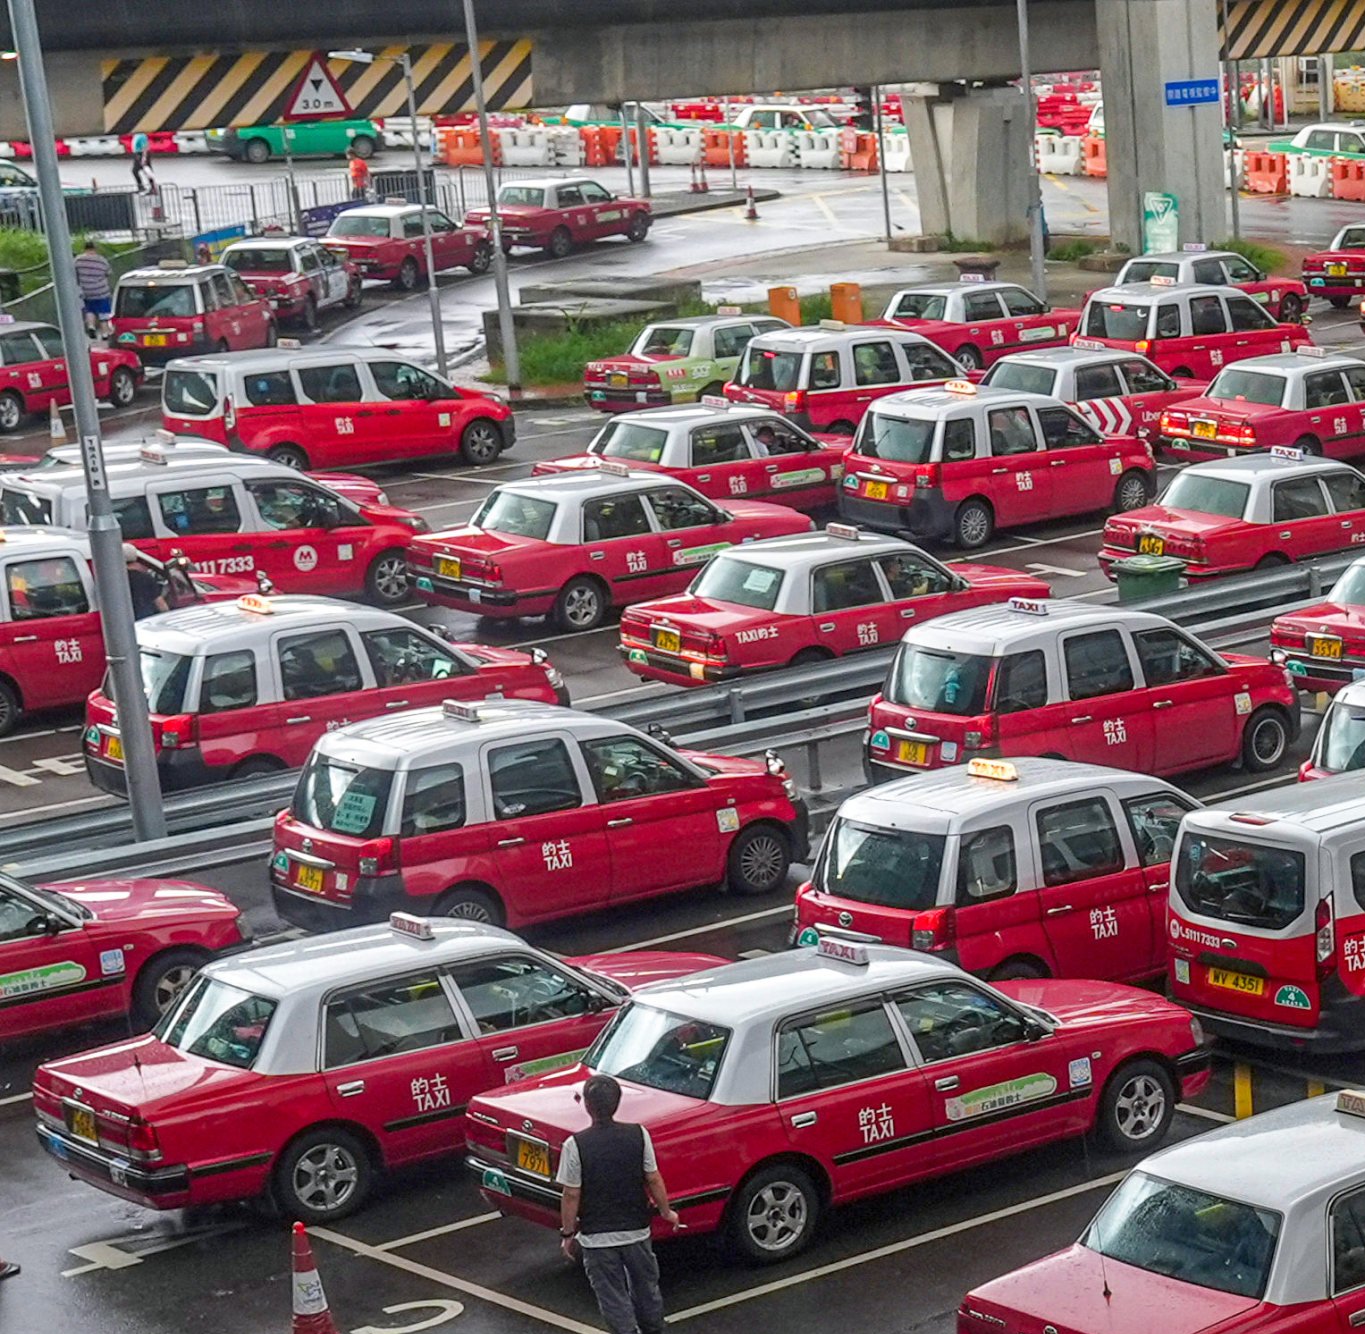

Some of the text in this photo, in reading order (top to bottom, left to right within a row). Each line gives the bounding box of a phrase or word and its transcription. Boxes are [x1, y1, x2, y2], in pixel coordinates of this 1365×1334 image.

[302, 97, 337, 110] 3.0 m
[1275, 448, 1296, 458] TAXI
[216, 557, 254, 575] 7333
[1011, 601, 1038, 612] TAXI
[736, 625, 778, 644] TAXI的士
[857, 621, 874, 633] 的士
[54, 639, 80, 650] 的士
[858, 631, 878, 645] TAXI
[56, 648, 82, 663] TAXI
[1103, 718, 1124, 732] 的士
[1104, 729, 1126, 745] TAXI
[542, 840, 570, 854] 的士
[544, 852, 573, 871] TAXI
[1090, 906, 1115, 921] 的士
[1092, 920, 1118, 939] TAXI
[1185, 929, 1220, 948] 5111 7333
[821, 940, 857, 959] TAXI
[1231, 974, 1261, 993] 4351
[411, 1073, 446, 1091] 的士
[413, 1089, 450, 1111] TAXI
[859, 1104, 892, 1122] 的士
[861, 1120, 895, 1142] TAXI
